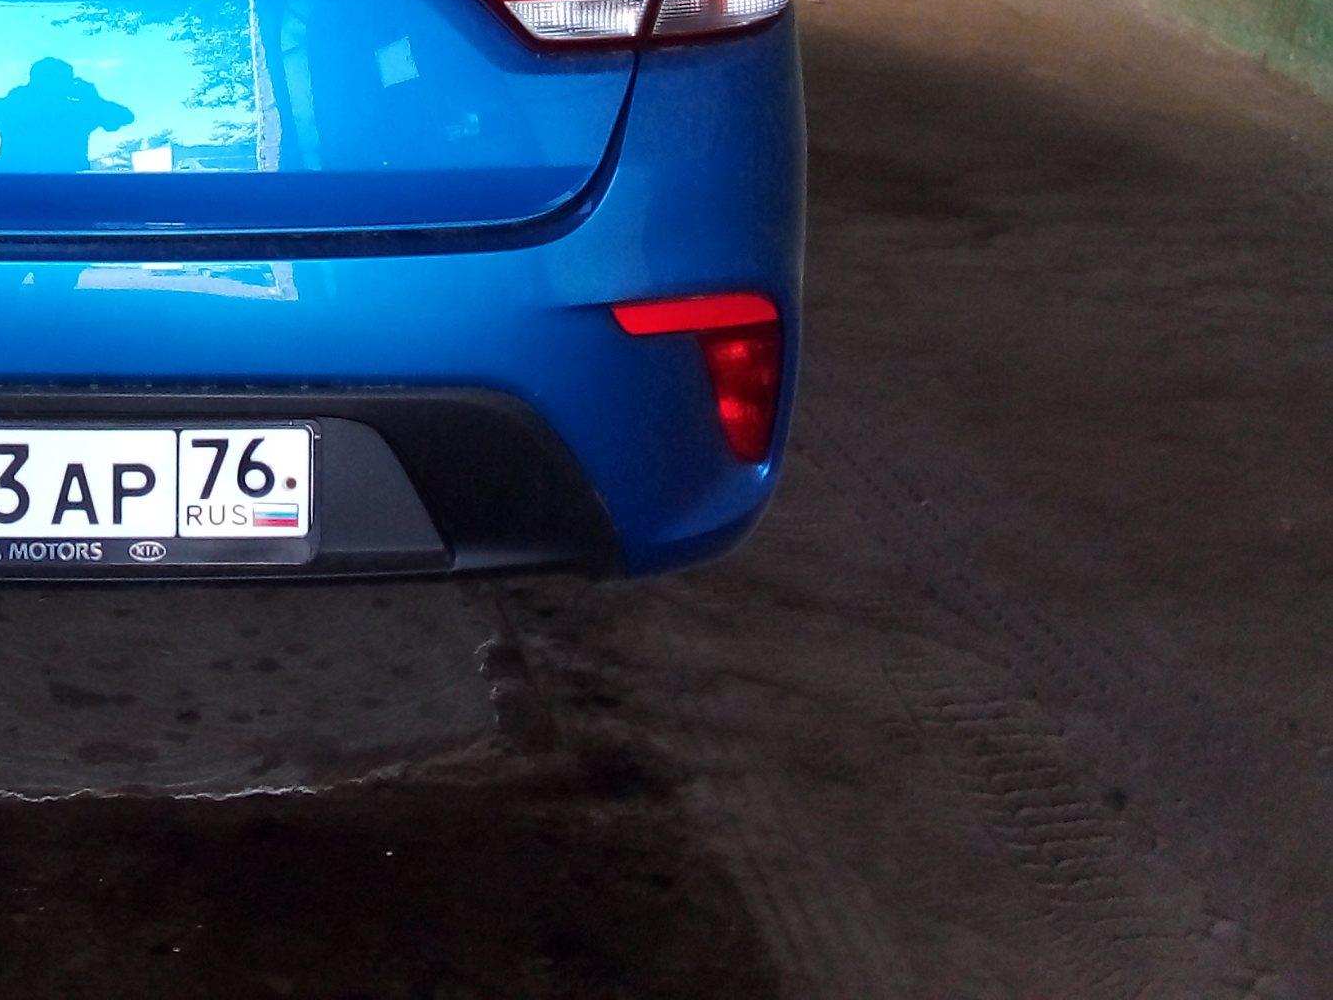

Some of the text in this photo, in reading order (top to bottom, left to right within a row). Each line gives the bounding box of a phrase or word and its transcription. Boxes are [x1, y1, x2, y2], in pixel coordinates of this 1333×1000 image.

[191, 438, 275, 500] 76
[186, 504, 248, 527] RUS
[9, 542, 103, 561] MOTORS
